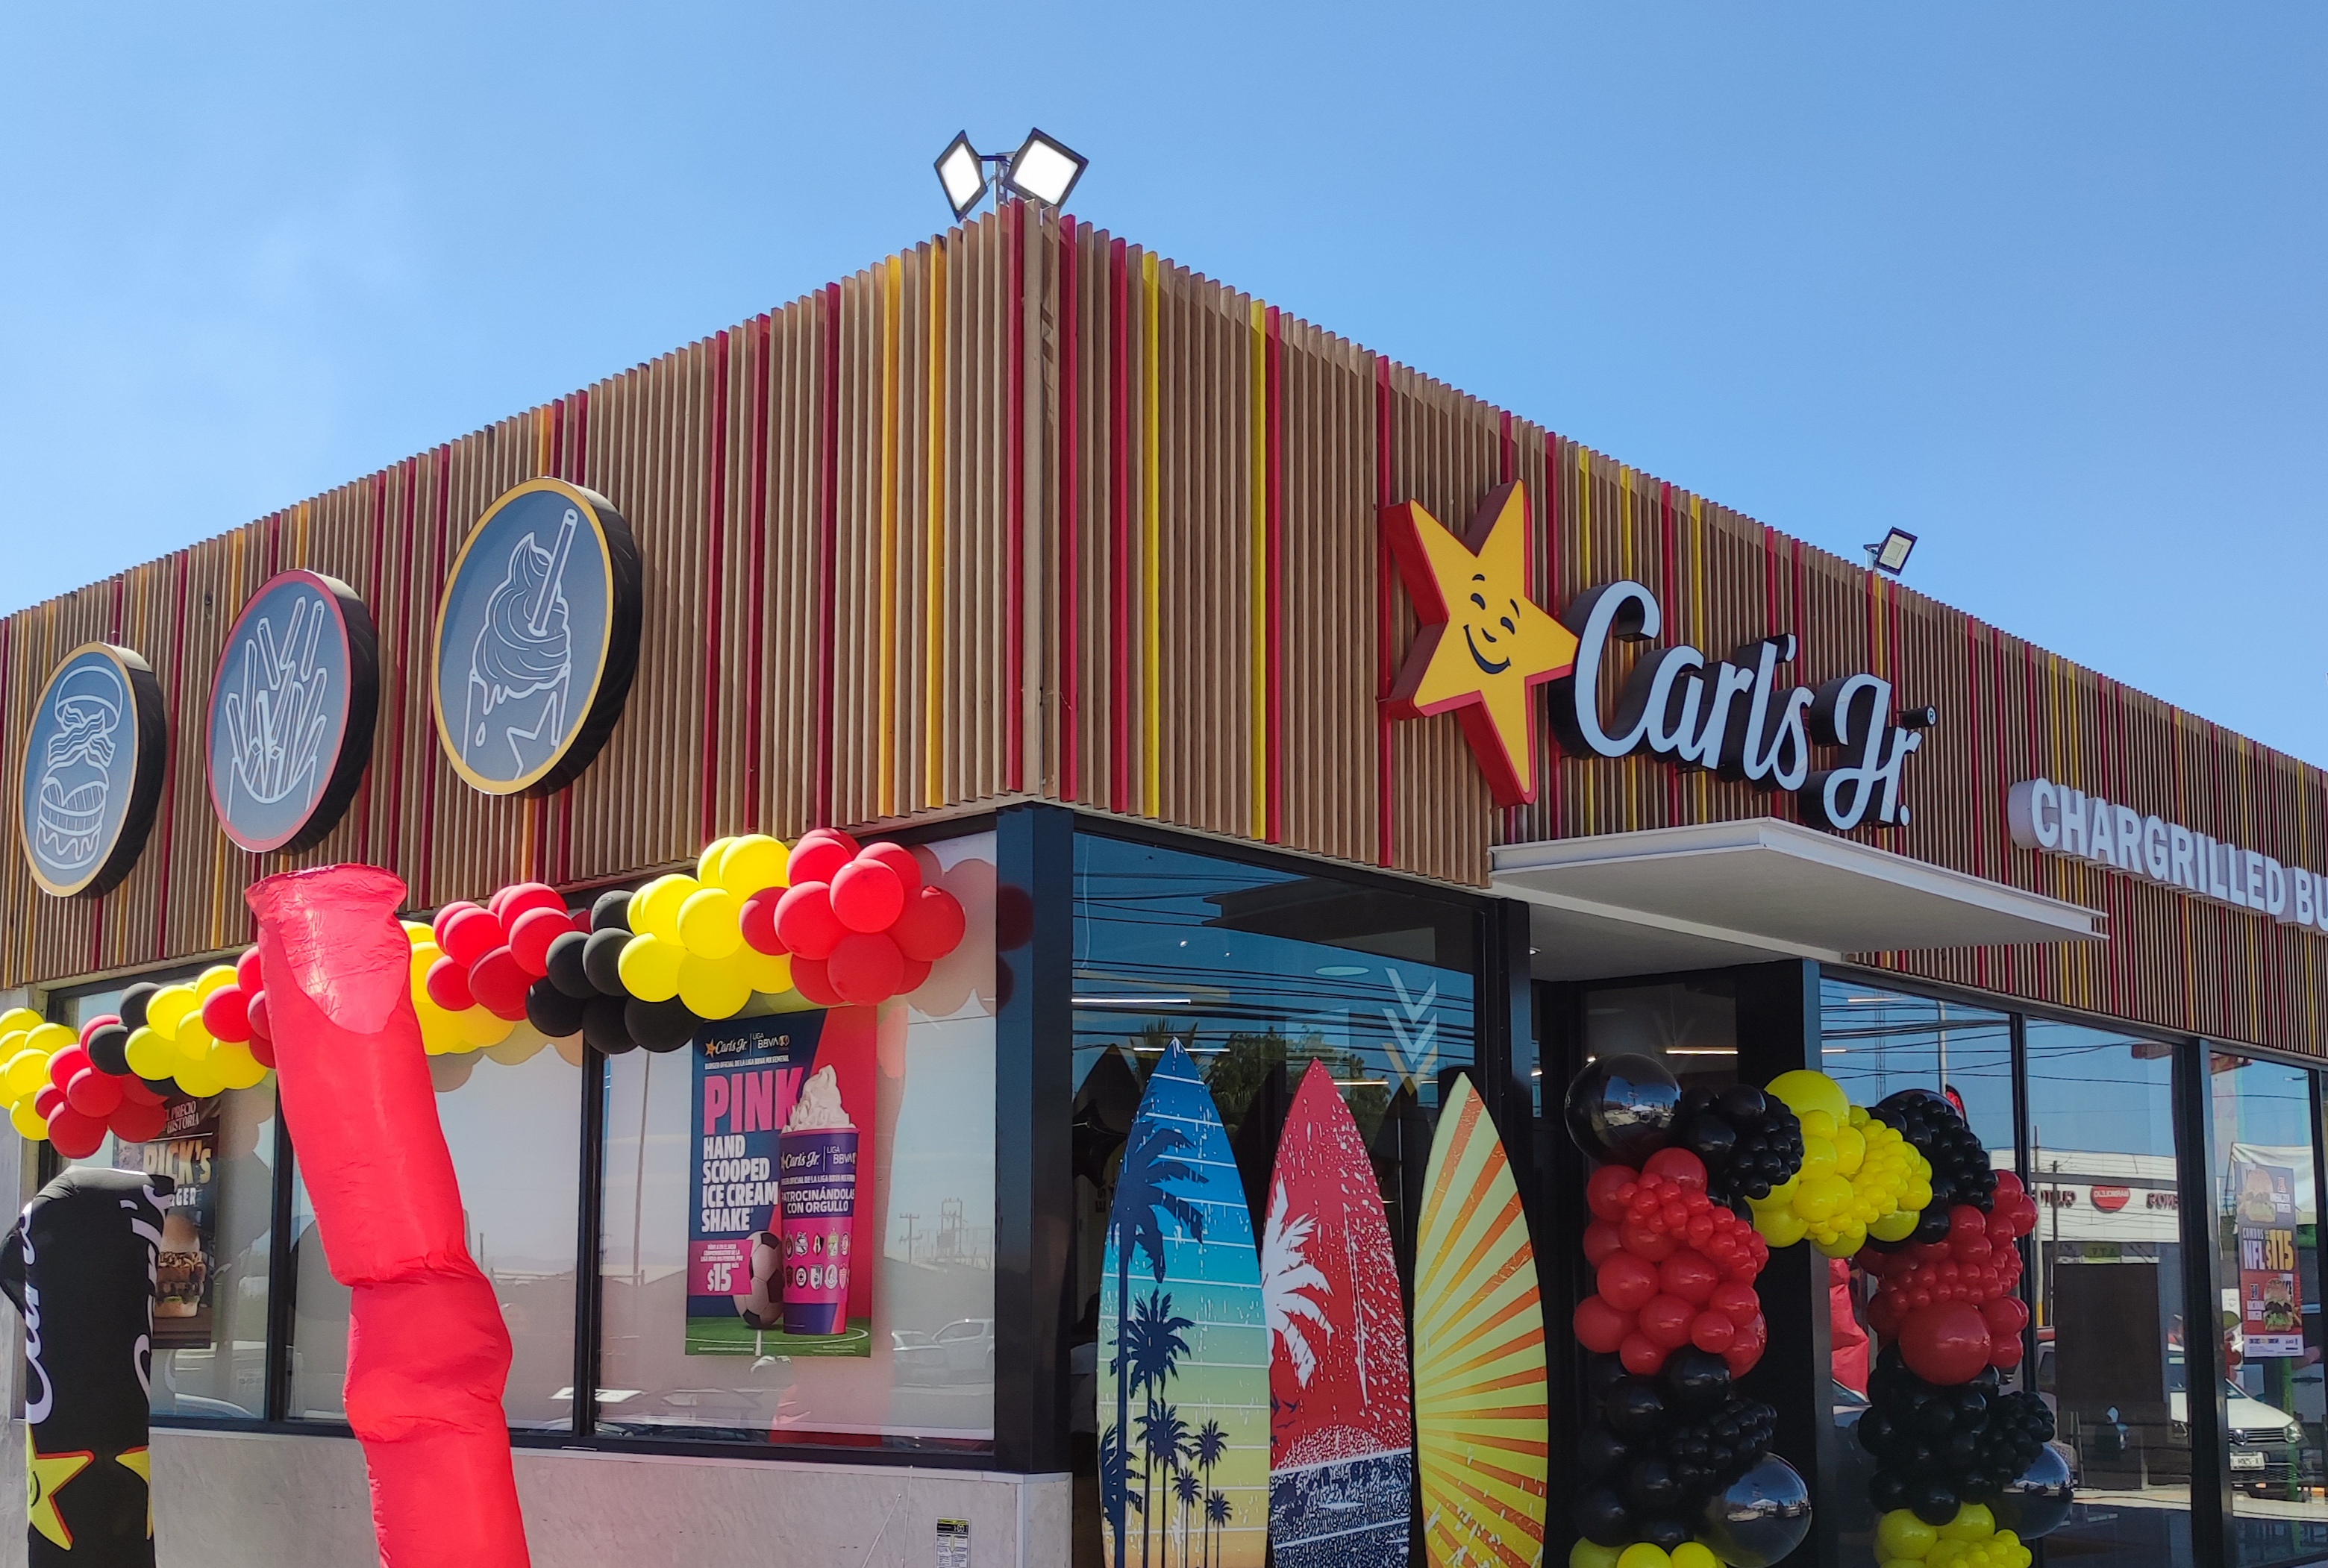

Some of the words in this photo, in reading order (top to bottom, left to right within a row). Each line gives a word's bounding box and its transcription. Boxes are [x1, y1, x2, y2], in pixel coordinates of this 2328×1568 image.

[1574, 579, 1816, 791] Carl's
[2030, 777, 2288, 917] CHARGRILLED
[757, 1036, 779, 1049] BBVA
[171, 1100, 196, 1120] PRECIO
[703, 1067, 804, 1135] PINK
[166, 1111, 200, 1135] HISTORIA
[703, 1134, 745, 1160] HAND
[827, 1146, 840, 1154] LIGA
[833, 1153, 852, 1164] BBVA
[702, 1157, 771, 1185] SCOOPED
[702, 1184, 726, 1208] ICE
[726, 1181, 778, 1207] CREAM
[787, 1202, 804, 1214] CON
[805, 1200, 849, 1213] ORGULLO
[701, 1207, 751, 1233] SHAKE
[2243, 1240, 2266, 1270] NFL
[2265, 1229, 2294, 1271] $115
[707, 1262, 732, 1292] $15
